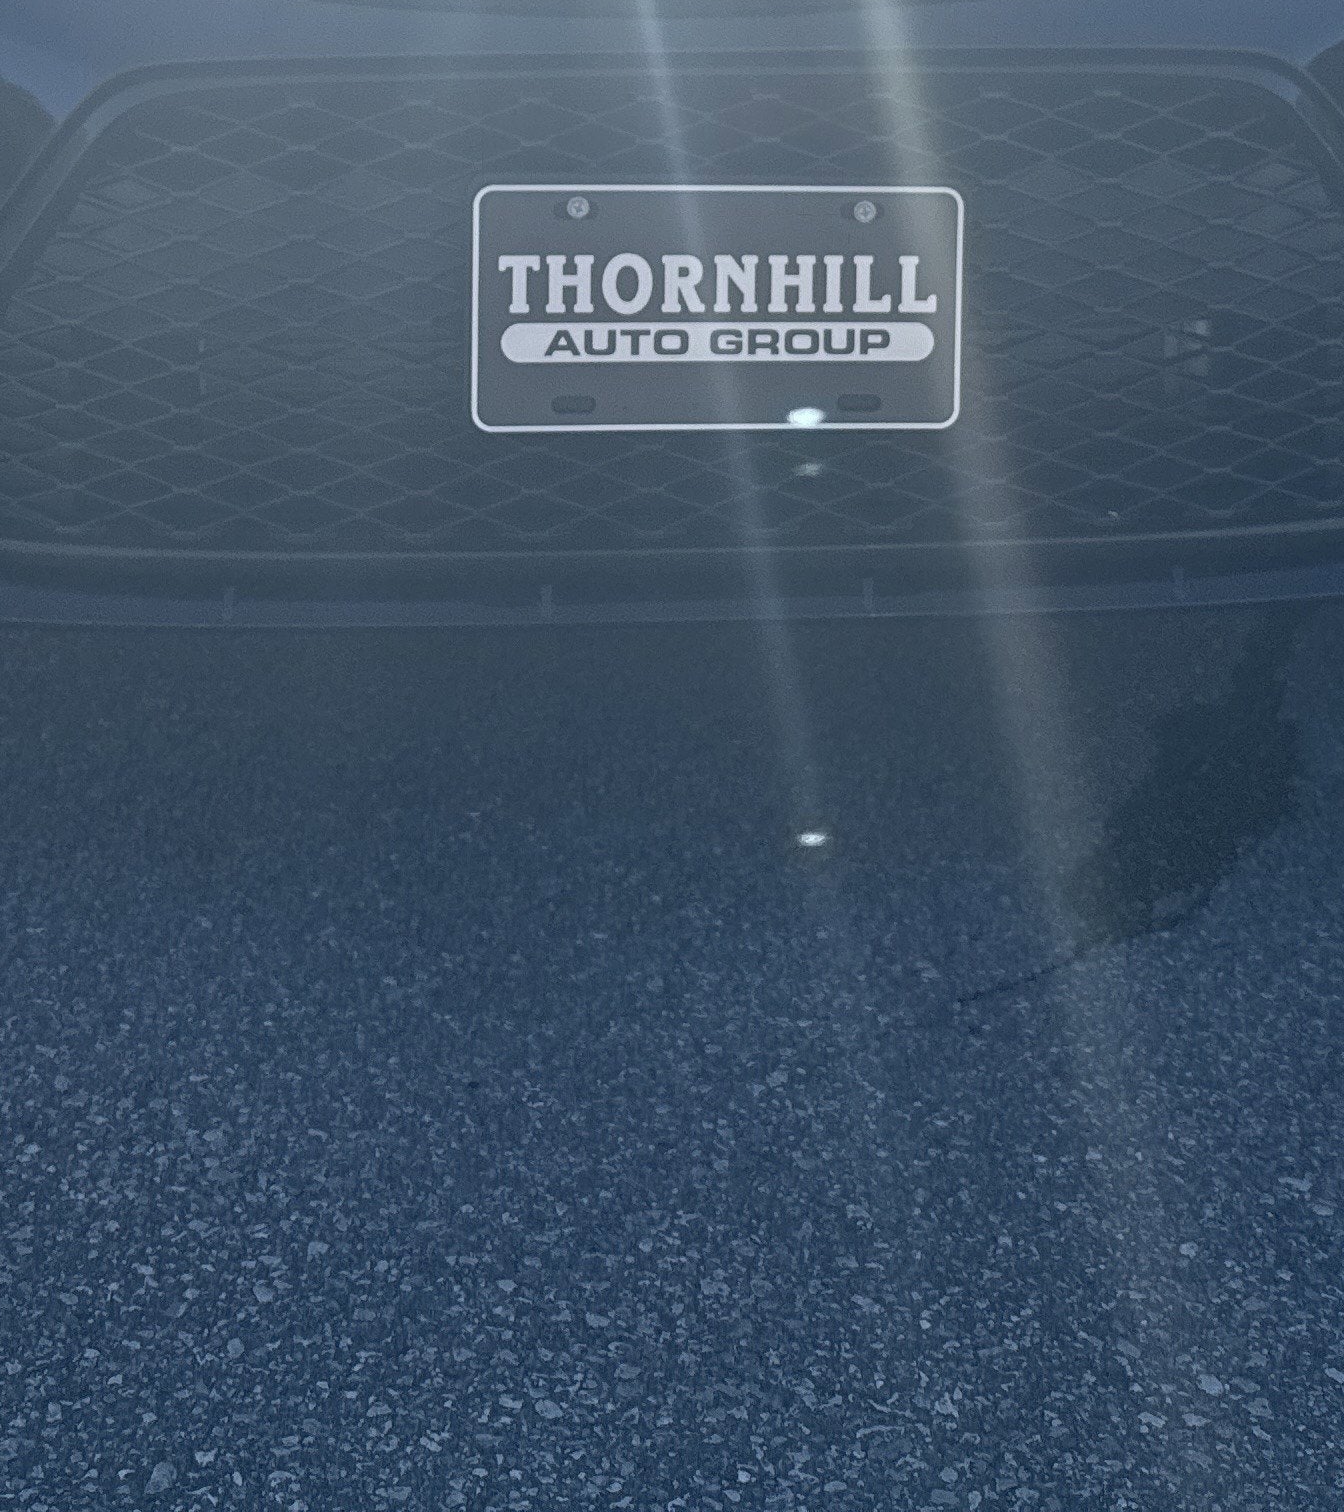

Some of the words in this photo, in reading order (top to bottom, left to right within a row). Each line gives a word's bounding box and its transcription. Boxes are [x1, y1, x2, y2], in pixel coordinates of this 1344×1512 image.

[498, 253, 938, 314] THORNHILL
[544, 329, 690, 356] AUTO
[710, 329, 891, 355] GROUP
